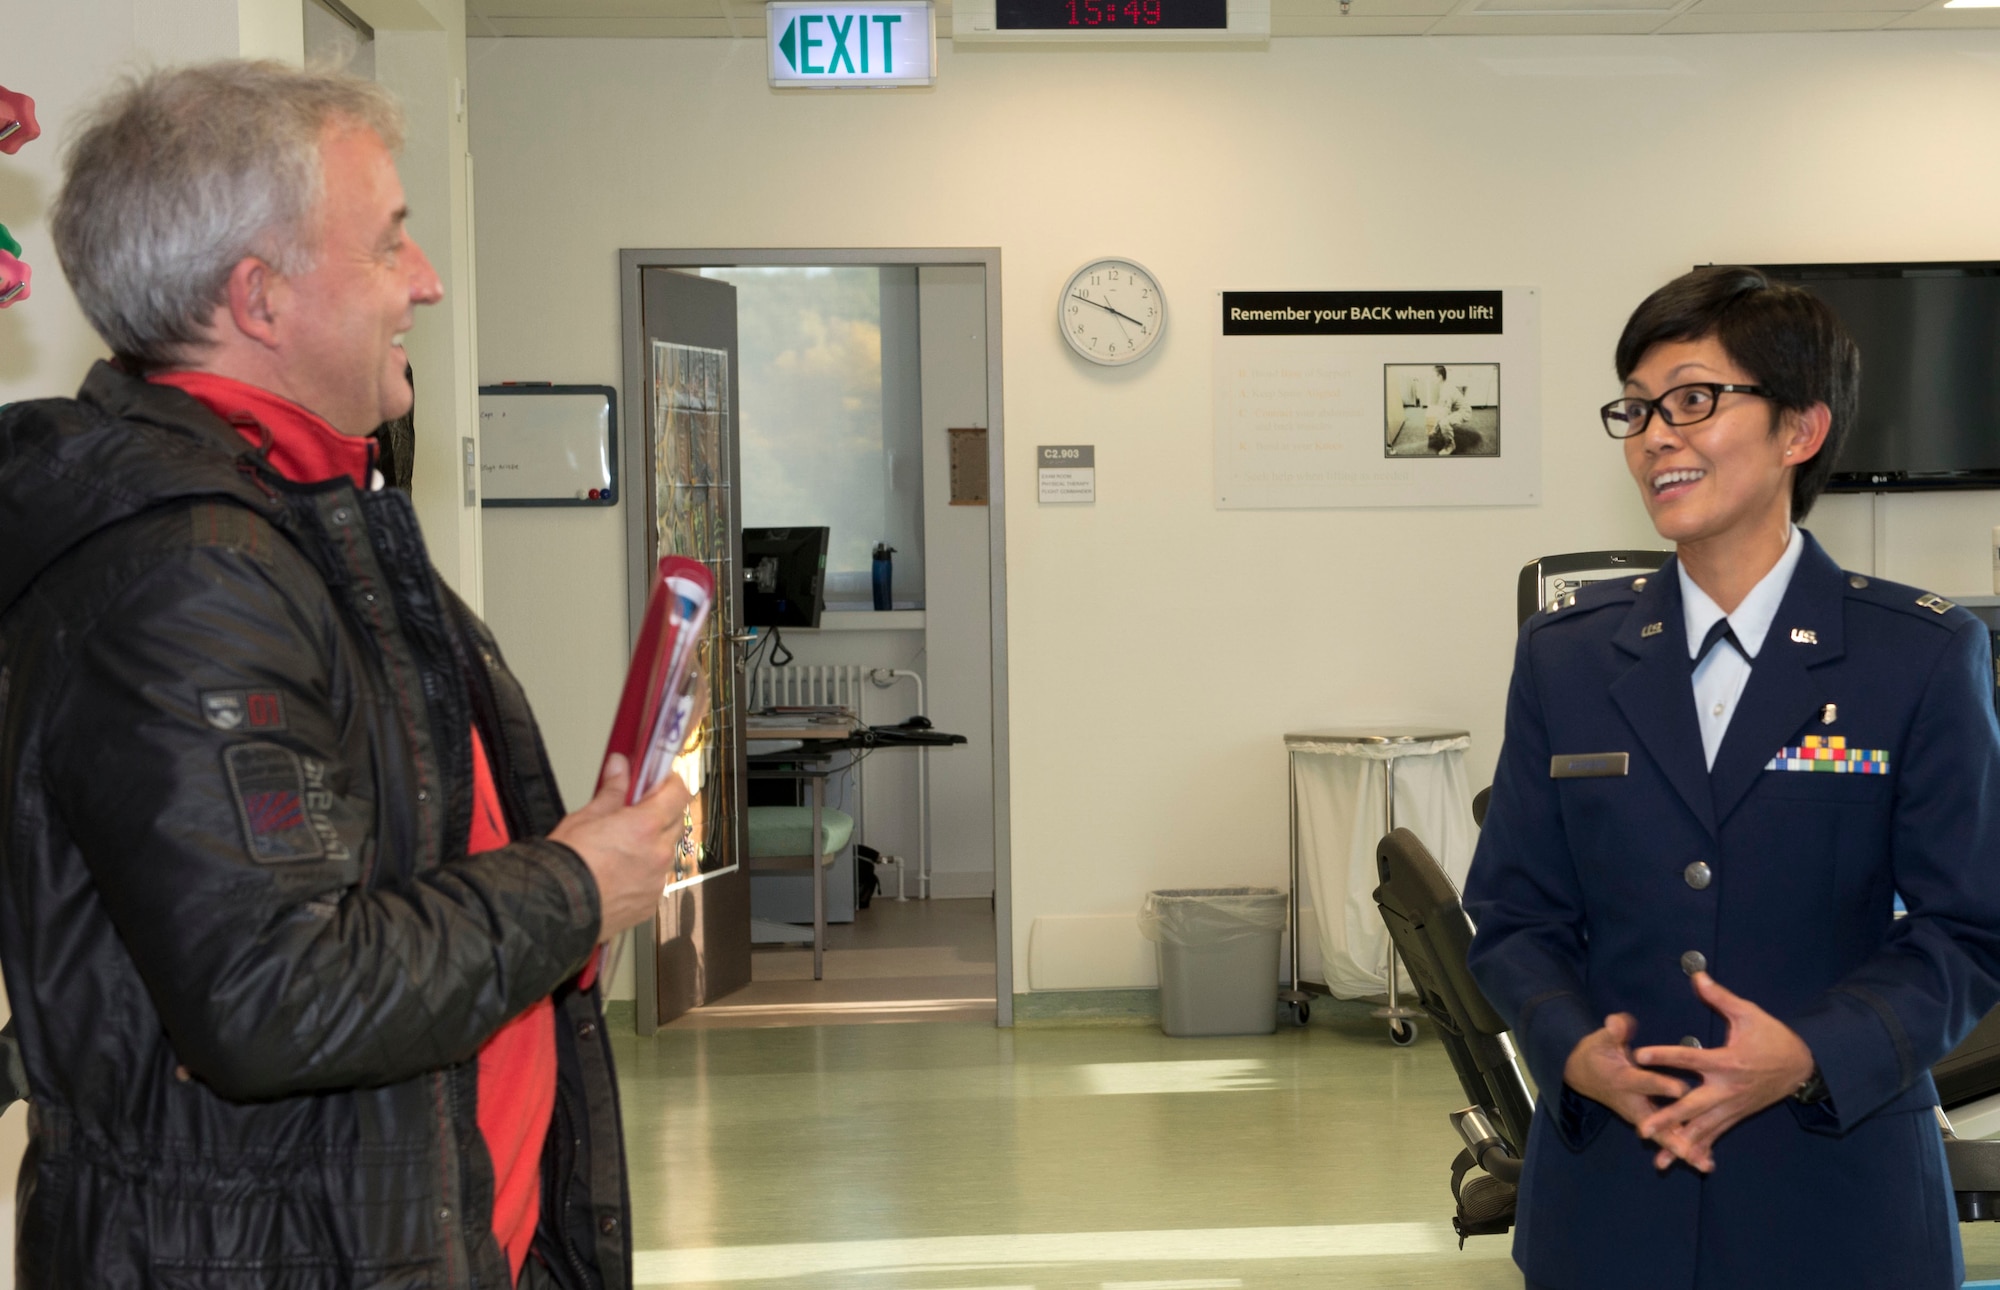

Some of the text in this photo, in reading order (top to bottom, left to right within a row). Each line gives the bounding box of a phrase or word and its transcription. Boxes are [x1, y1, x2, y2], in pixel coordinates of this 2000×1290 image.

[1065, 0, 1161, 25] 15:49
[800, 15, 902, 74] EXIT
[1108, 271, 1119, 280] 12
[1091, 276, 1100, 286] 11
[1129, 276, 1133, 286] 1
[1078, 289, 1089, 298] 10
[1142, 289, 1148, 299] 2
[1072, 306, 1079, 315] 9
[1147, 307, 1153, 317] 3
[1231, 306, 1494, 324] Remember your BACK when you lift!
[1077, 325, 1084, 334] 8
[1140, 325, 1147, 335] 4
[1091, 337, 1098, 347] 7
[1109, 342, 1116, 352] 6
[1127, 339, 1134, 349] 5
[1044, 449, 1079, 459] C2.903
[247, 693, 281, 727] 01
